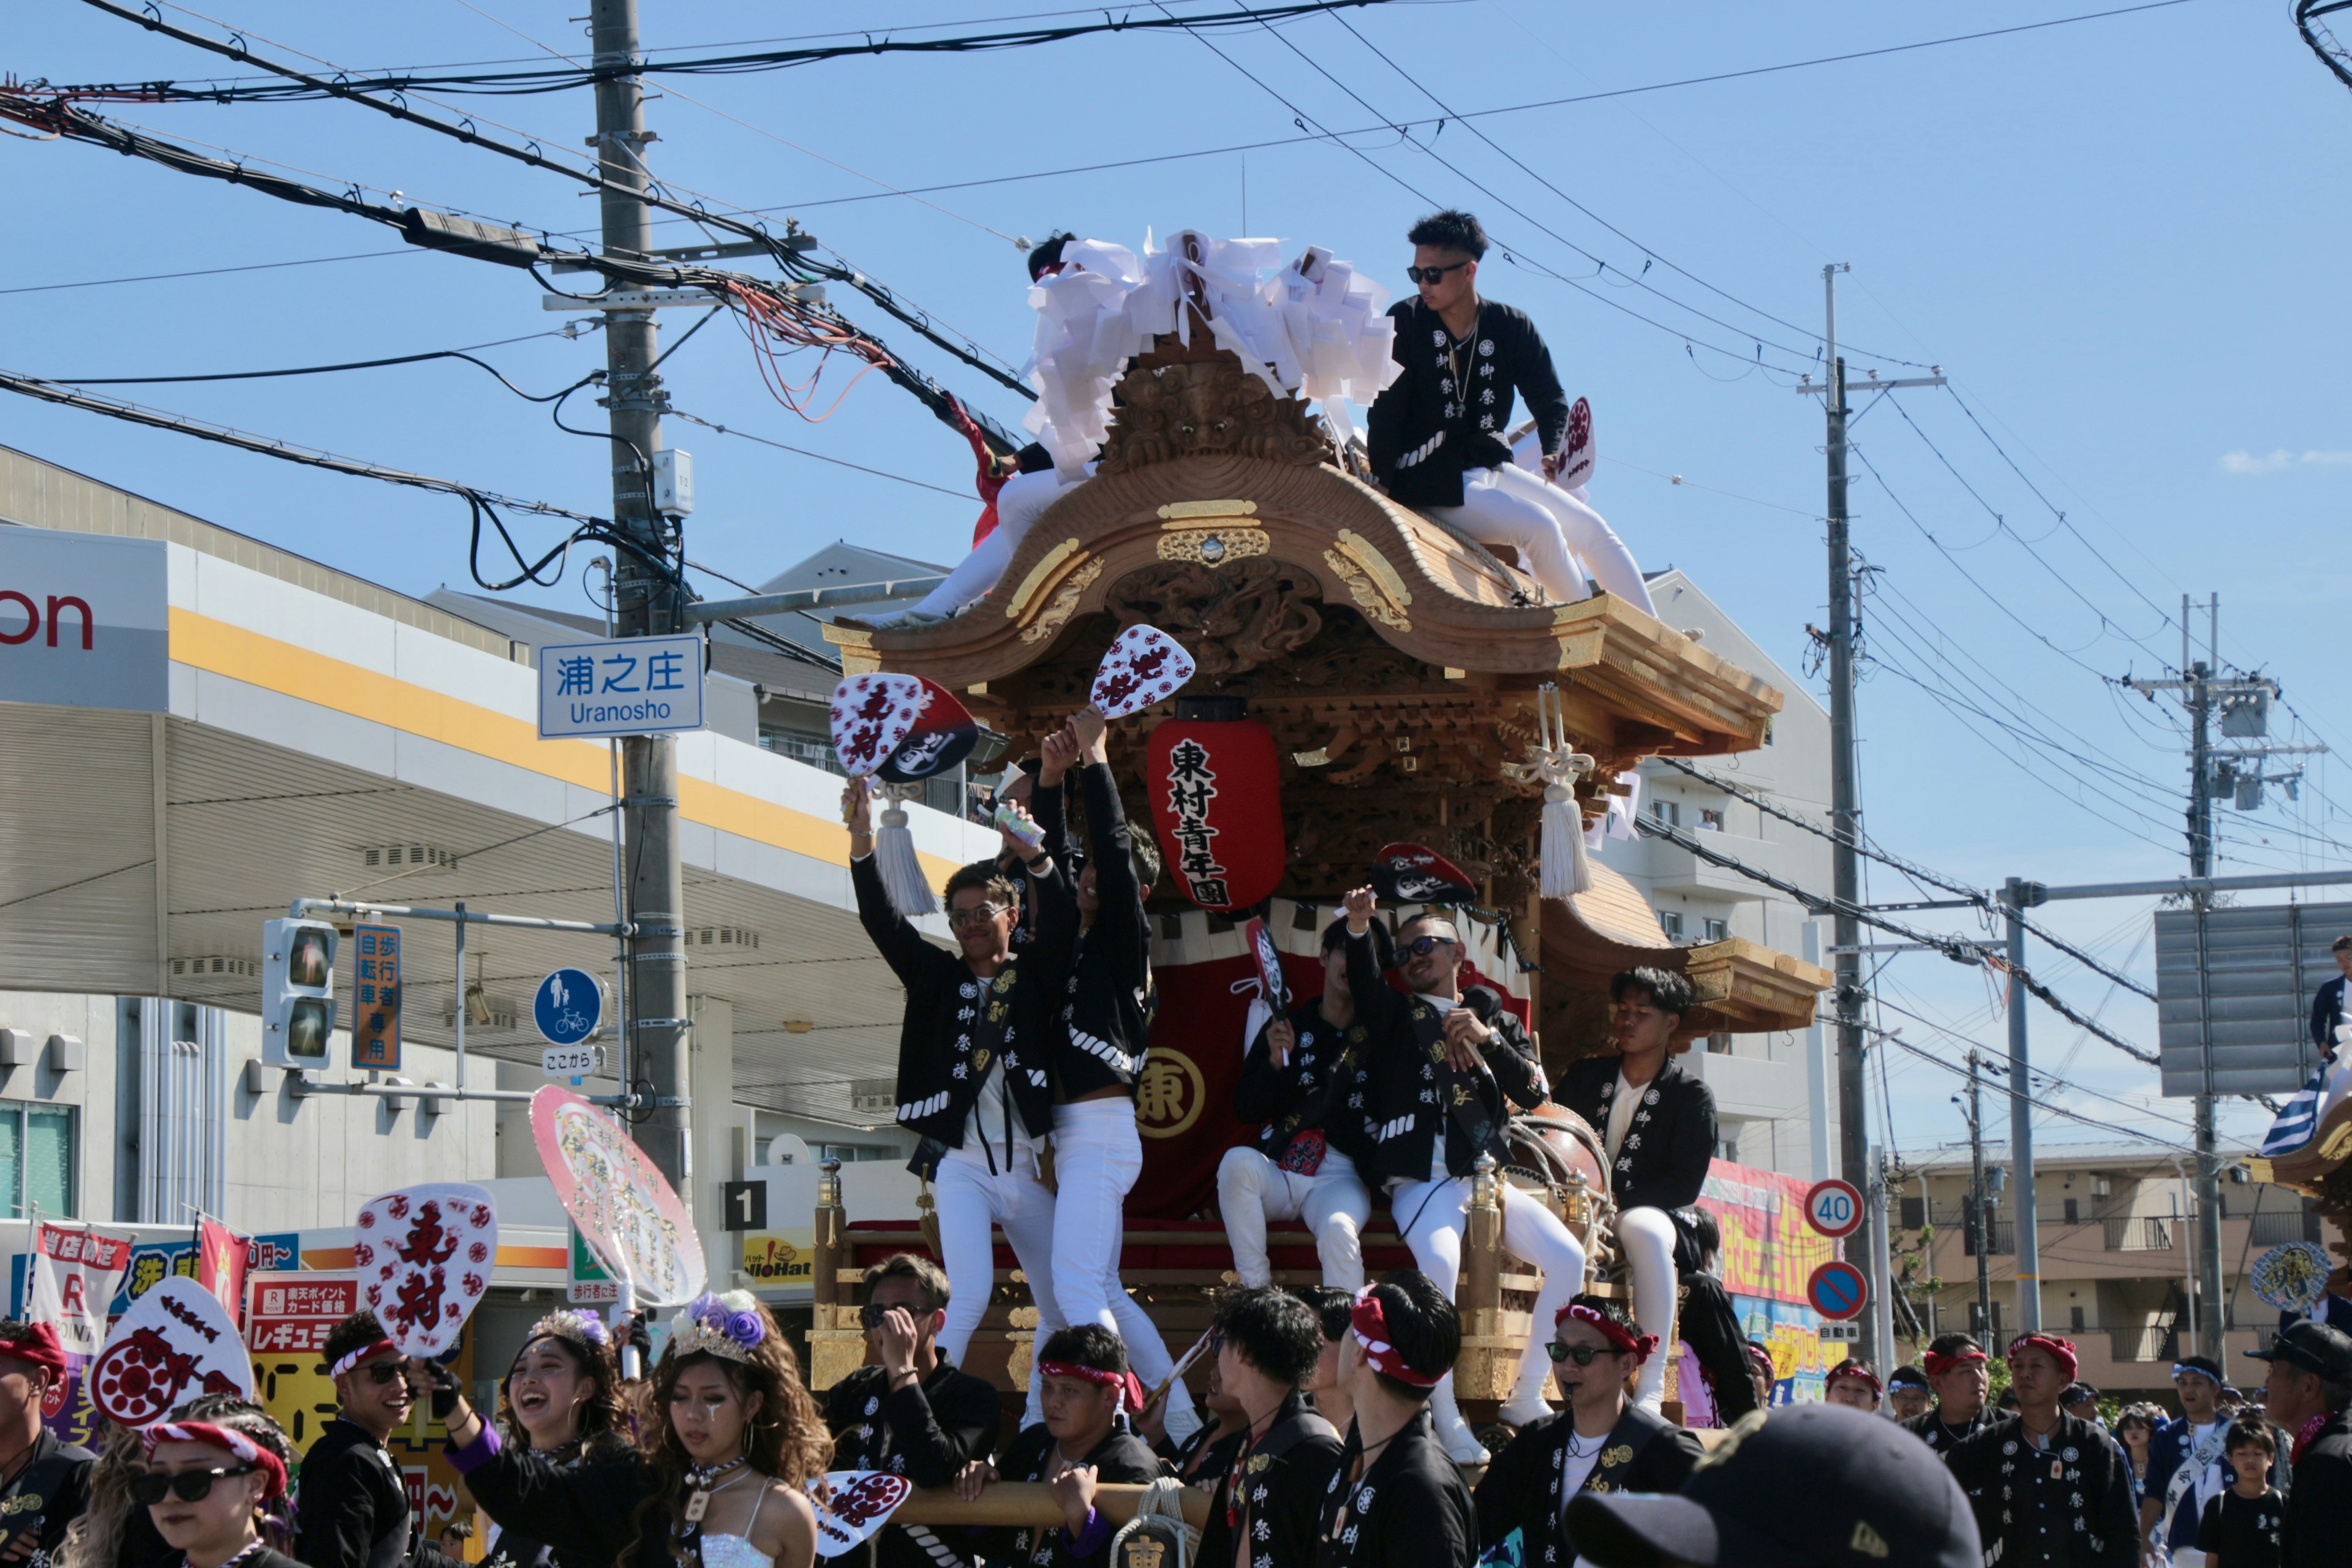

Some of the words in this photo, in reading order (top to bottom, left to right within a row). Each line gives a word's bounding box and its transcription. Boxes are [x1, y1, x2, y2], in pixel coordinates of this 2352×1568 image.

[1479, 363, 1496, 431] 御祭禮
[557, 650, 684, 696] 浦之庄
[570, 699, 671, 724] Uranosho
[360, 934, 377, 1006] 自転車
[379, 935, 396, 1007] 歩行者
[368, 1012, 386, 1061] 専用
[952, 1005, 976, 1081] 御祭禮
[546, 1052, 590, 1070] ここから
[1616, 1109, 1652, 1173] 御祭禮
[736, 1189, 752, 1223] 1
[1818, 1196, 1850, 1221] 40
[43, 1230, 117, 1267] 当店限定
[62, 1273, 85, 1312] R
[271, 1292, 278, 1303] R
[287, 1300, 345, 1313] カード価格
[288, 1287, 346, 1300] 楽天ポイント
[573, 1284, 618, 1300] 歩行者に注
[54, 1319, 93, 1343] POINT
[1820, 1327, 1858, 1338] 自動車
